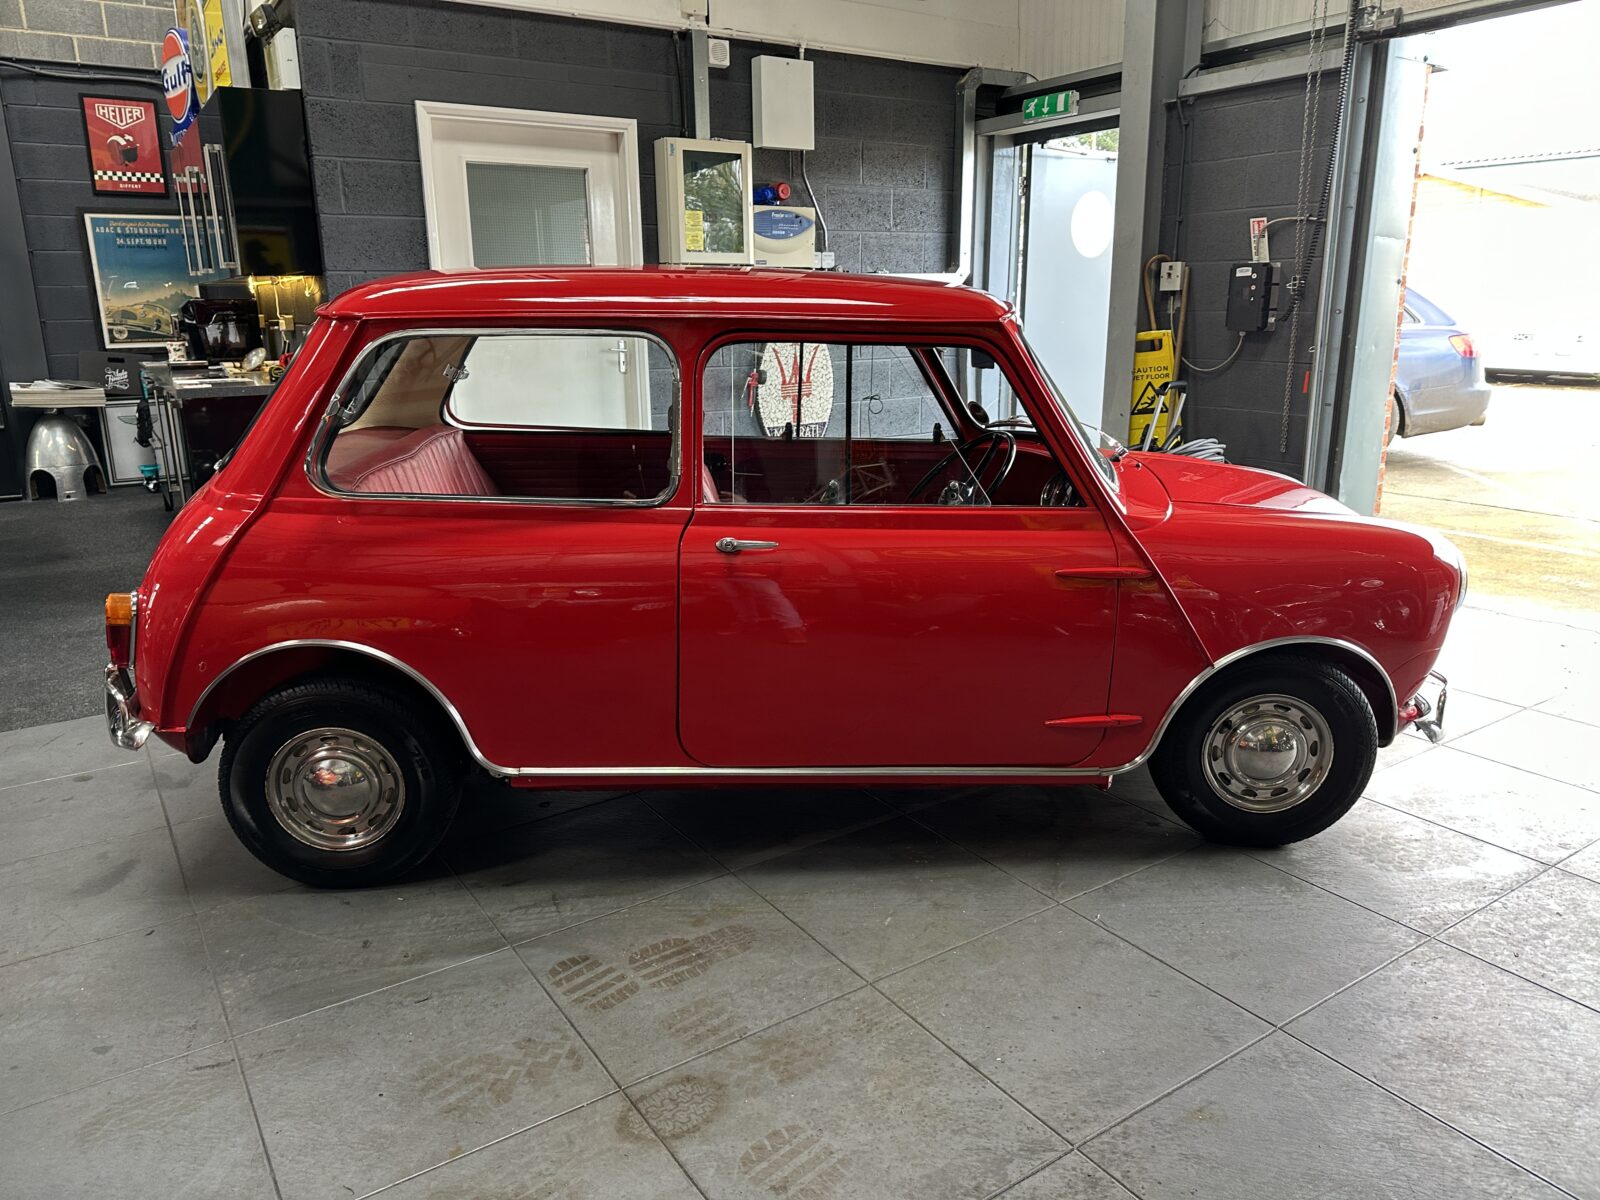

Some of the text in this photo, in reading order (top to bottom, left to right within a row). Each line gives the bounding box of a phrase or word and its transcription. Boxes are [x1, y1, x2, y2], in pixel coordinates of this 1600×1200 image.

[162, 60, 191, 94] Gulf
[98, 105, 142, 126] HEUER
[125, 226, 180, 235] STUNDEN-FAHR
